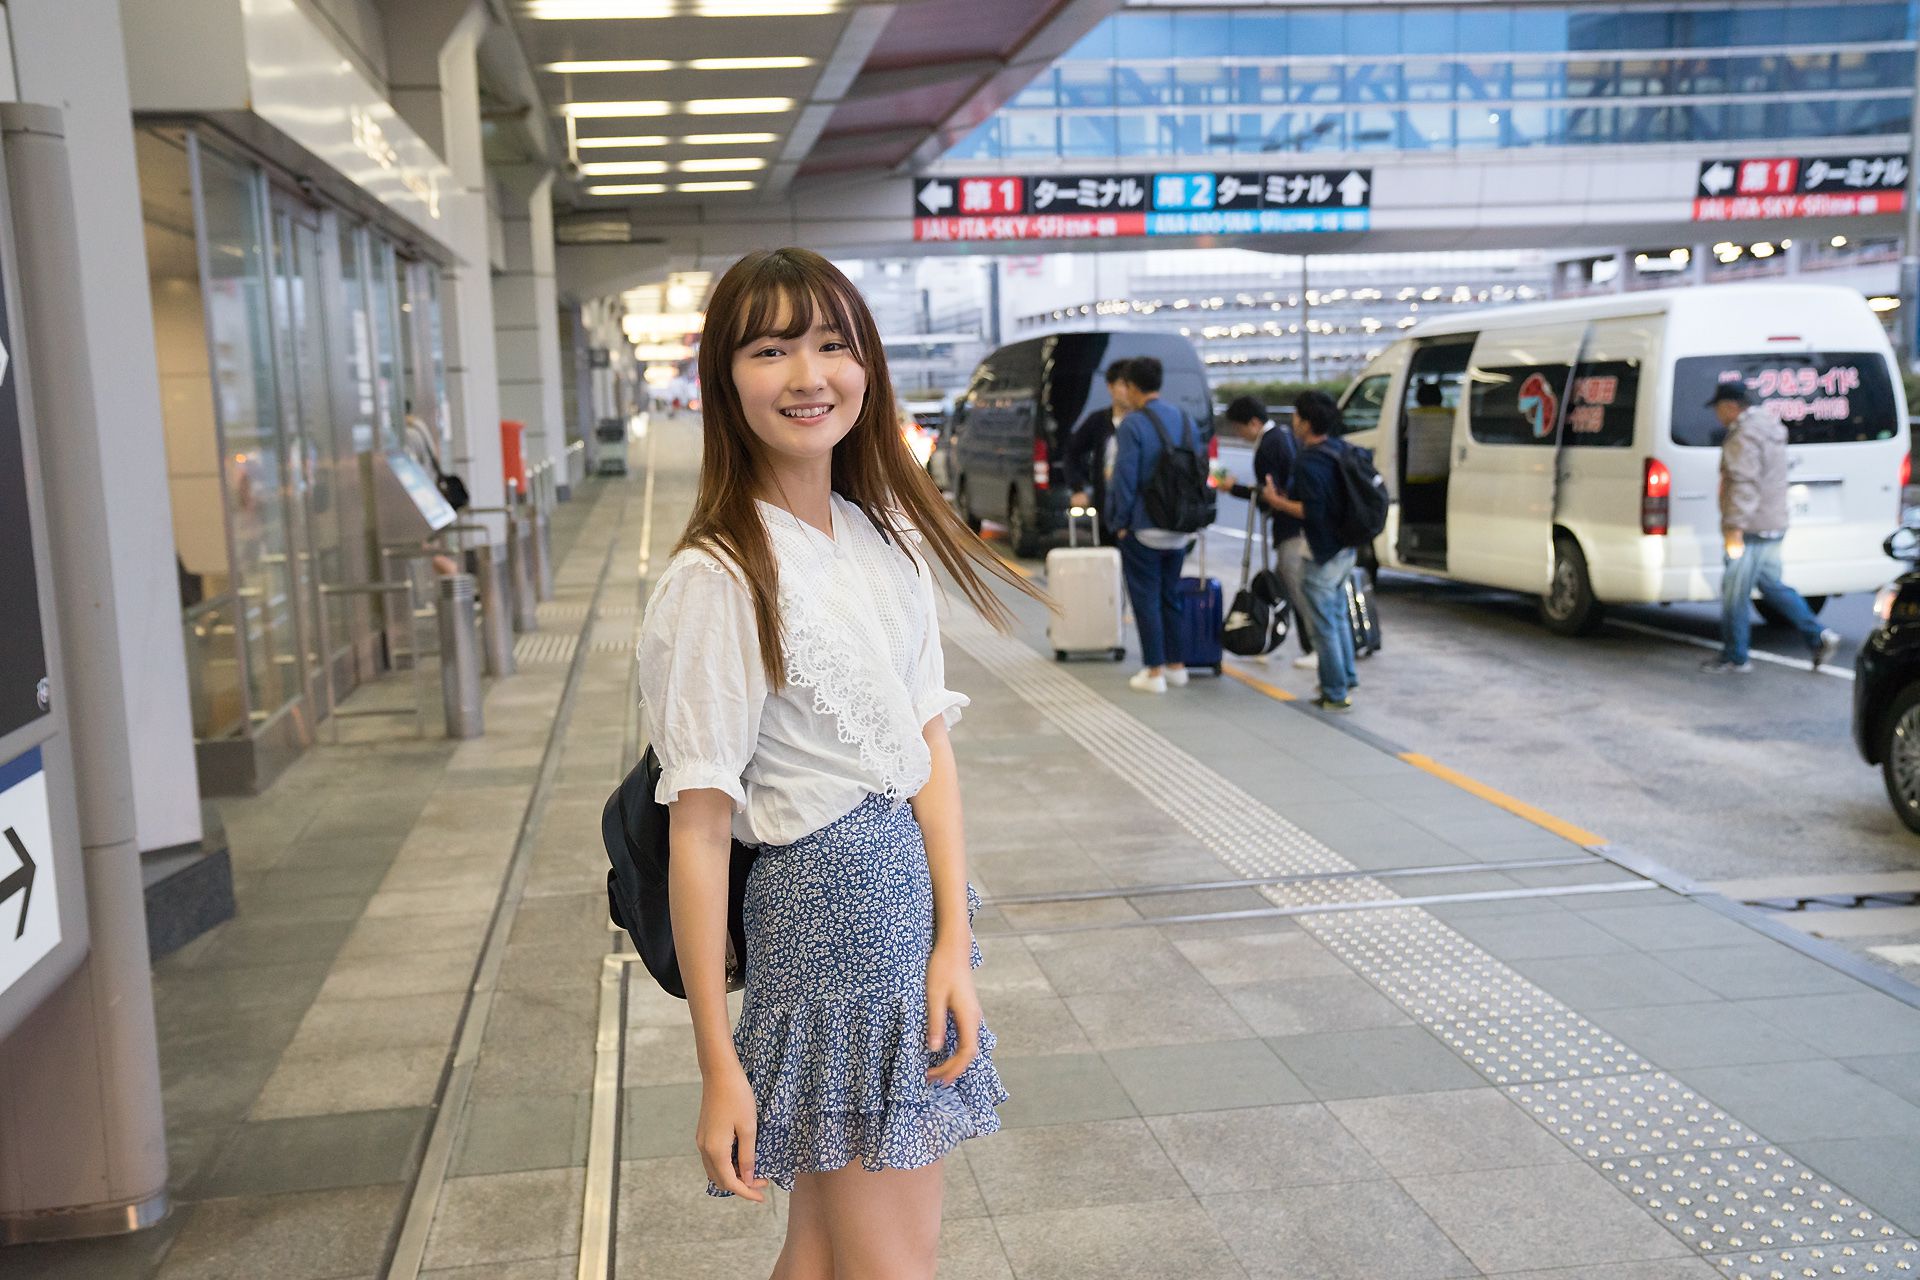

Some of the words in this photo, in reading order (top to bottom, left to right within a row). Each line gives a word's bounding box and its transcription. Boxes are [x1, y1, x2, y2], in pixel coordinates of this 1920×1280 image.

[1804, 156, 1909, 189] ターミナル
[1032, 177, 1145, 209] ターミナル
[1216, 173, 1333, 206] ターミナル
